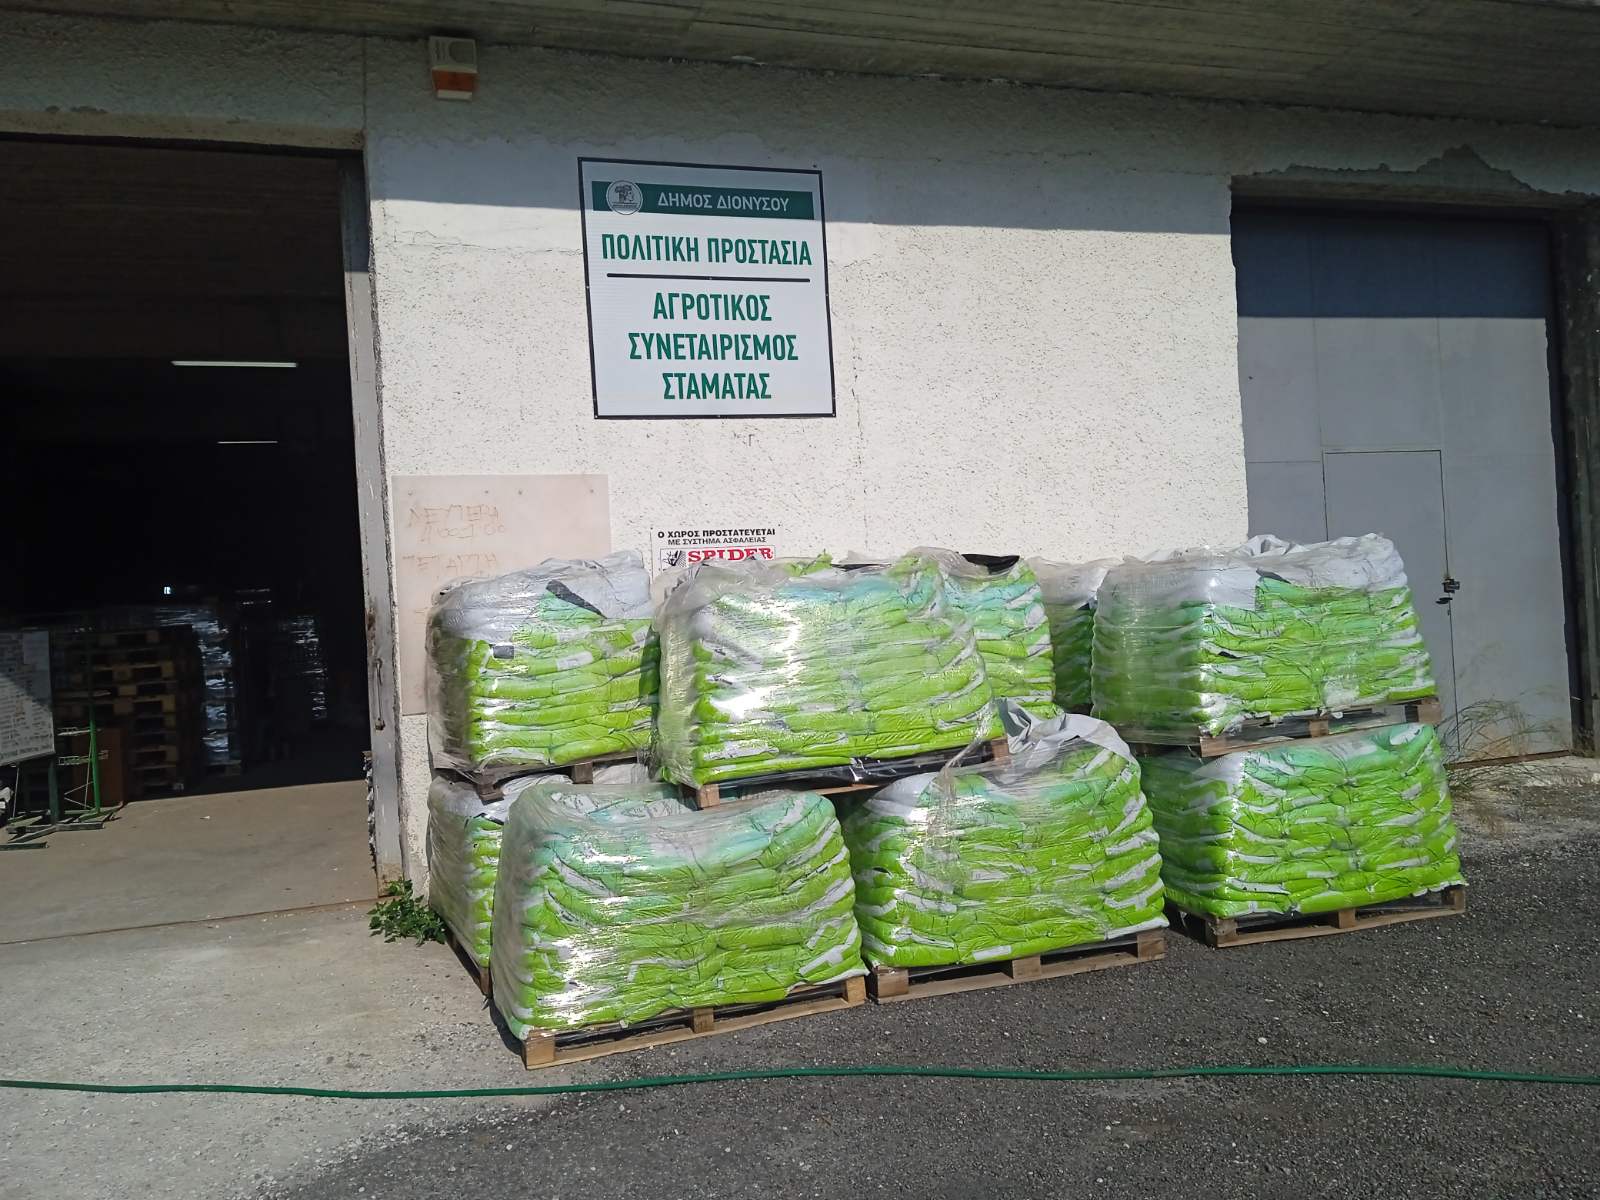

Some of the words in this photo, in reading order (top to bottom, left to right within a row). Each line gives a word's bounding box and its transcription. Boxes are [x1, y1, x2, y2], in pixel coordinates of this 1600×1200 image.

[657, 192, 713, 210] ΔΗΜΟΣ
[716, 194, 789, 212] ΔΙΟΝΥΣΟΥ
[601, 233, 699, 262] ΠΟΛΙΤΙΚΗ
[707, 238, 812, 265] ΠΡΟΣΤΑΣΙΑ
[653, 292, 772, 321] ΑΓΡΟΤΙΚΟΣ
[628, 332, 799, 361] ΣΥΝΕΤΑΙΡΙΣΜΟΣ
[662, 372, 772, 400] ΣΤΑΜΑΤΑΣ
[667, 530, 700, 538] ΧΩΡΟΣ
[702, 528, 775, 536] ΠΡΟΣΤΑΤΕΥΕΤΑΙ
[688, 547, 773, 562] SPIDER
